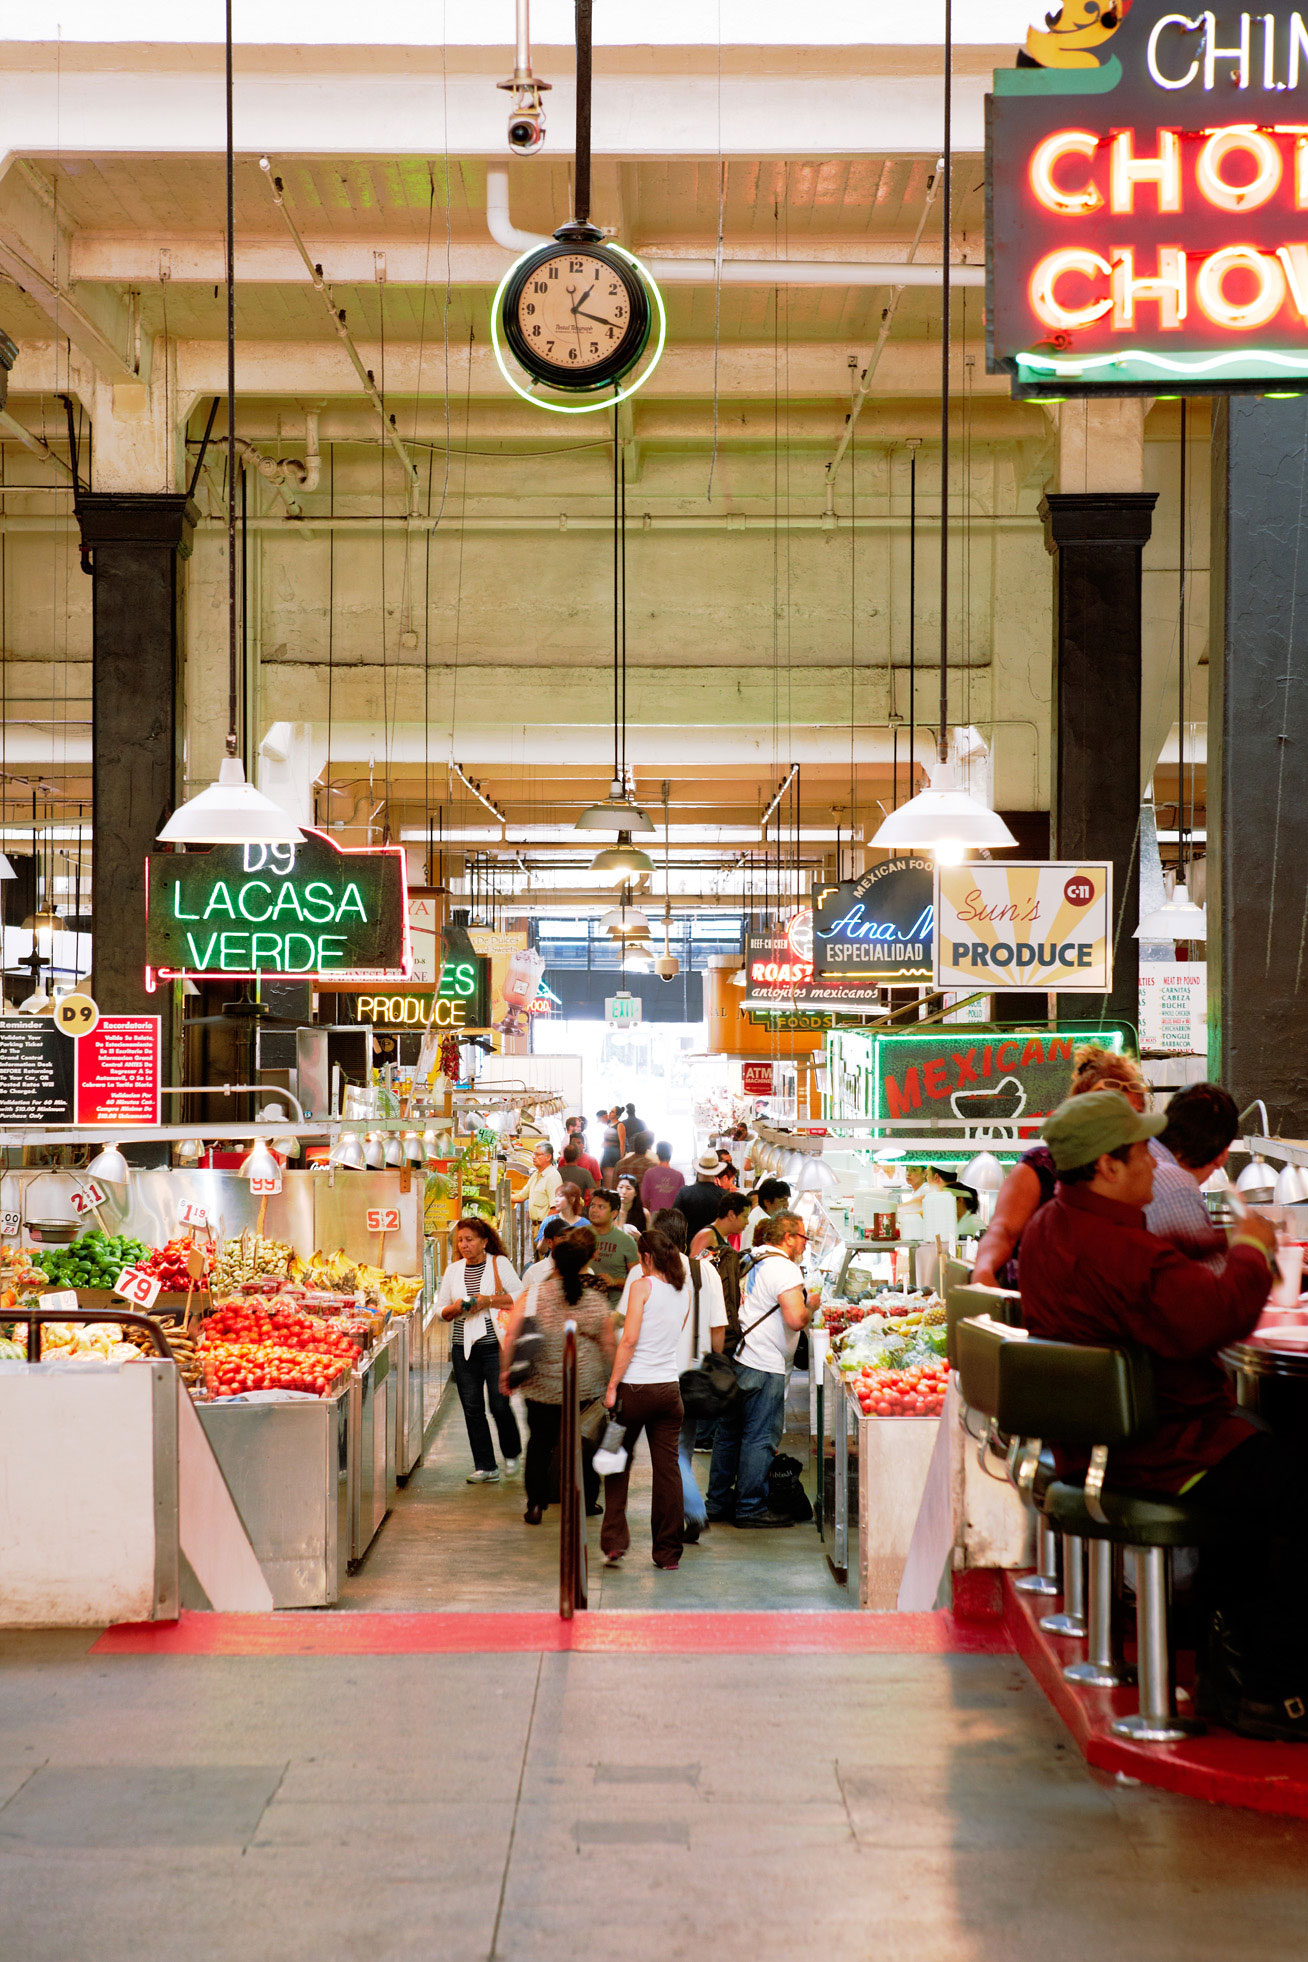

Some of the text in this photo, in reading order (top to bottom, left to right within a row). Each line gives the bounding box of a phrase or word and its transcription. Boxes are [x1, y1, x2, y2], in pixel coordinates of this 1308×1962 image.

[548, 267, 558, 279] 11
[569, 261, 584, 273] 12
[594, 268, 599, 280] 1
[534, 282, 548, 294] 10
[608, 284, 618, 295] 2
[526, 303, 535, 315] 9
[614, 306, 623, 318] 3
[532, 325, 541, 336] 8
[605, 327, 614, 339] 4
[546, 341, 555, 352] 7
[590, 342, 599, 354] 5
[568, 348, 577, 360] 6
[244, 843, 296, 875] D9
[853, 861, 907, 898] MEXICAN
[956, 890, 1041, 922] Sun's
[817, 904, 896, 940] Ana
[750, 939, 788, 949] BEEF-CHCKEN
[187, 932, 348, 973] VERDE
[826, 943, 923, 962] ESPECIALIDAD
[952, 942, 1094, 966] PRODUCE
[1164, 976, 1200, 985] MEAT BY POUND
[752, 985, 878, 1001] antojitos mexicanos
[357, 996, 466, 1026] PRODUCE
[612, 1000, 634, 1018] EXIT
[778, 1016, 832, 1028] FOODS
[746, 1068, 772, 1078] ATM
[884, 1037, 1074, 1119] MEXICAN
[120, 1270, 152, 1301] 79
